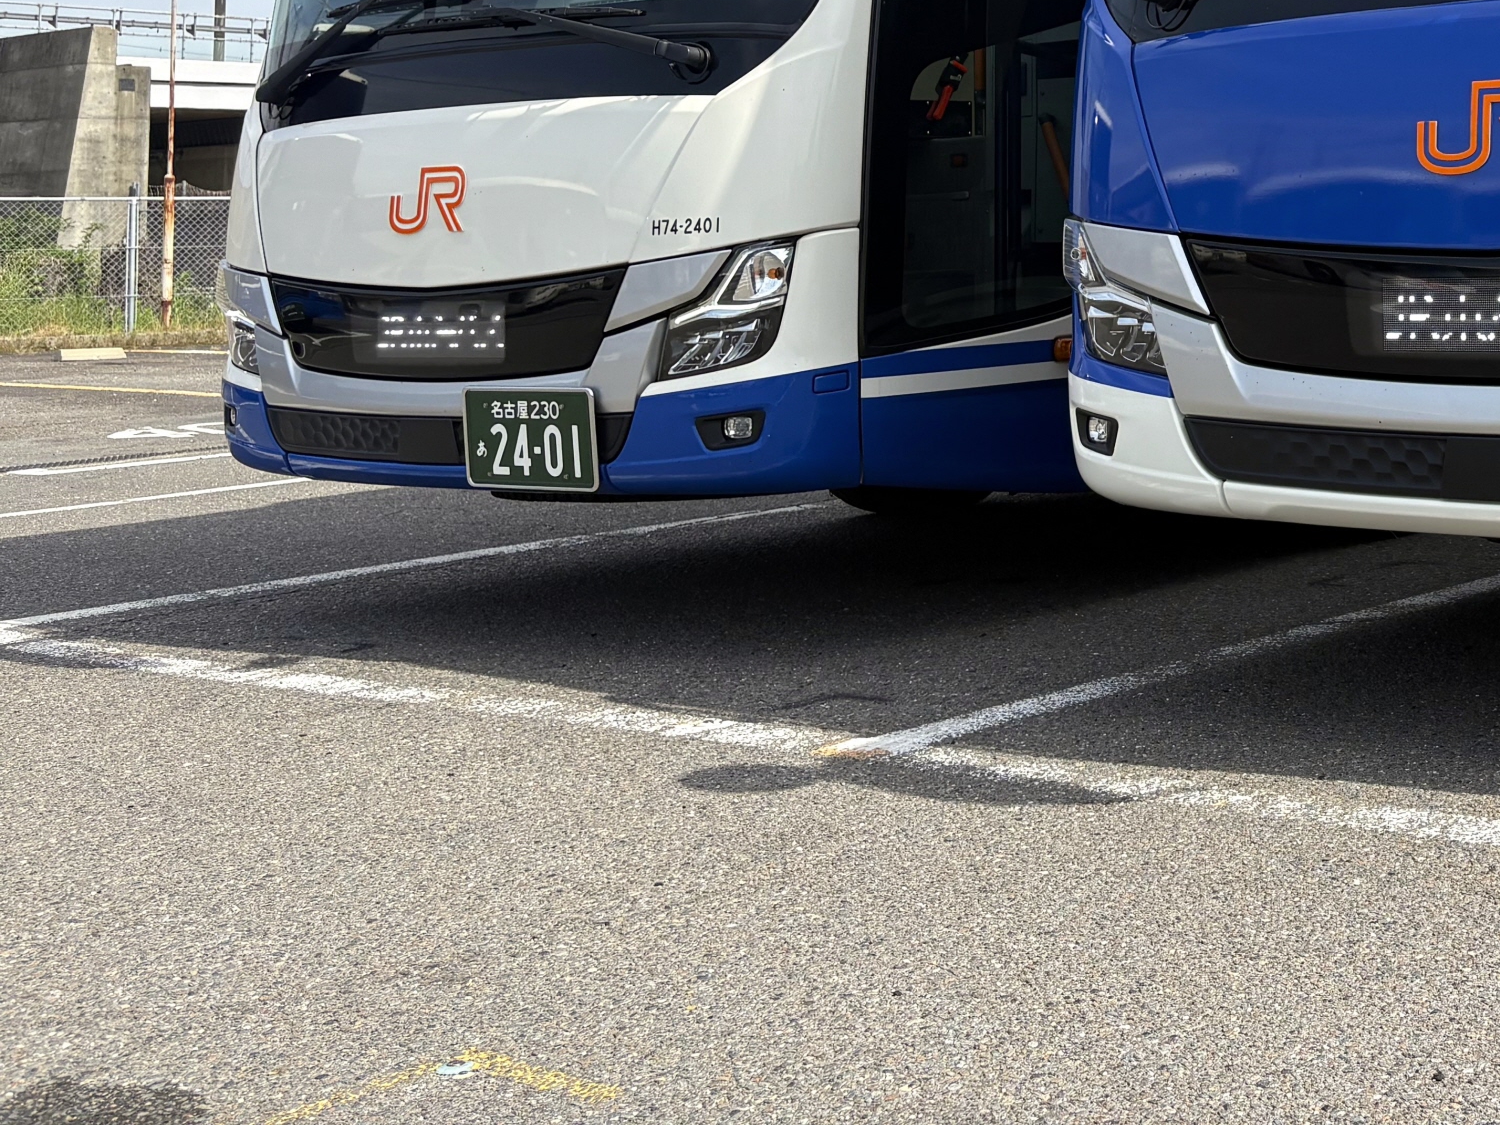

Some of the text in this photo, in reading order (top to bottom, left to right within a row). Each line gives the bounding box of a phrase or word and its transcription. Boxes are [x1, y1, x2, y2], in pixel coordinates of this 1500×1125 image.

[389, 164, 466, 235] JR
[652, 217, 720, 236] H74-2401
[476, 423, 582, 478] あ 24-01
